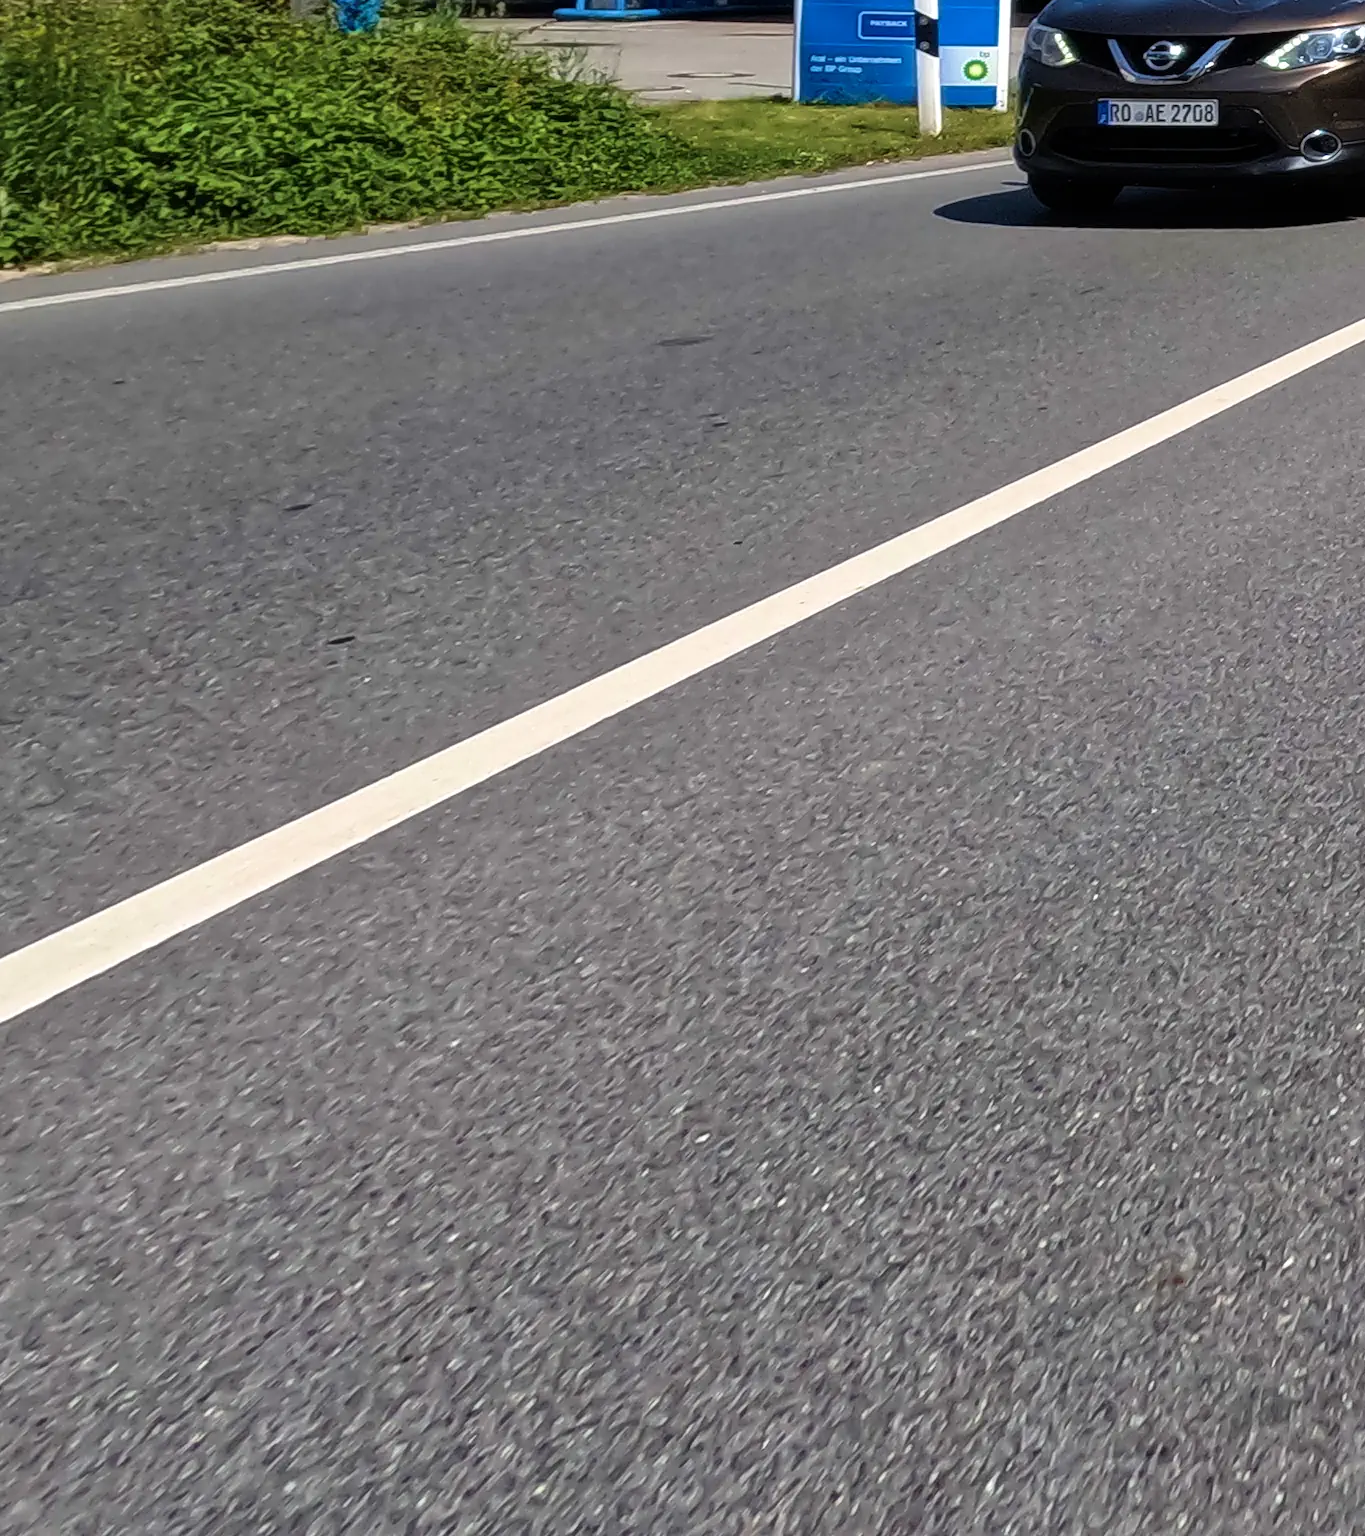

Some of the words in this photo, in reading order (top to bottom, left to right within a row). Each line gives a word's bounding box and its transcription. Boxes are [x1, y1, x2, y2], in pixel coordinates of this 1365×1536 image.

[1110, 104, 1131, 122] RO
[1145, 105, 1166, 122] AE
[1171, 105, 1213, 122] 2708
